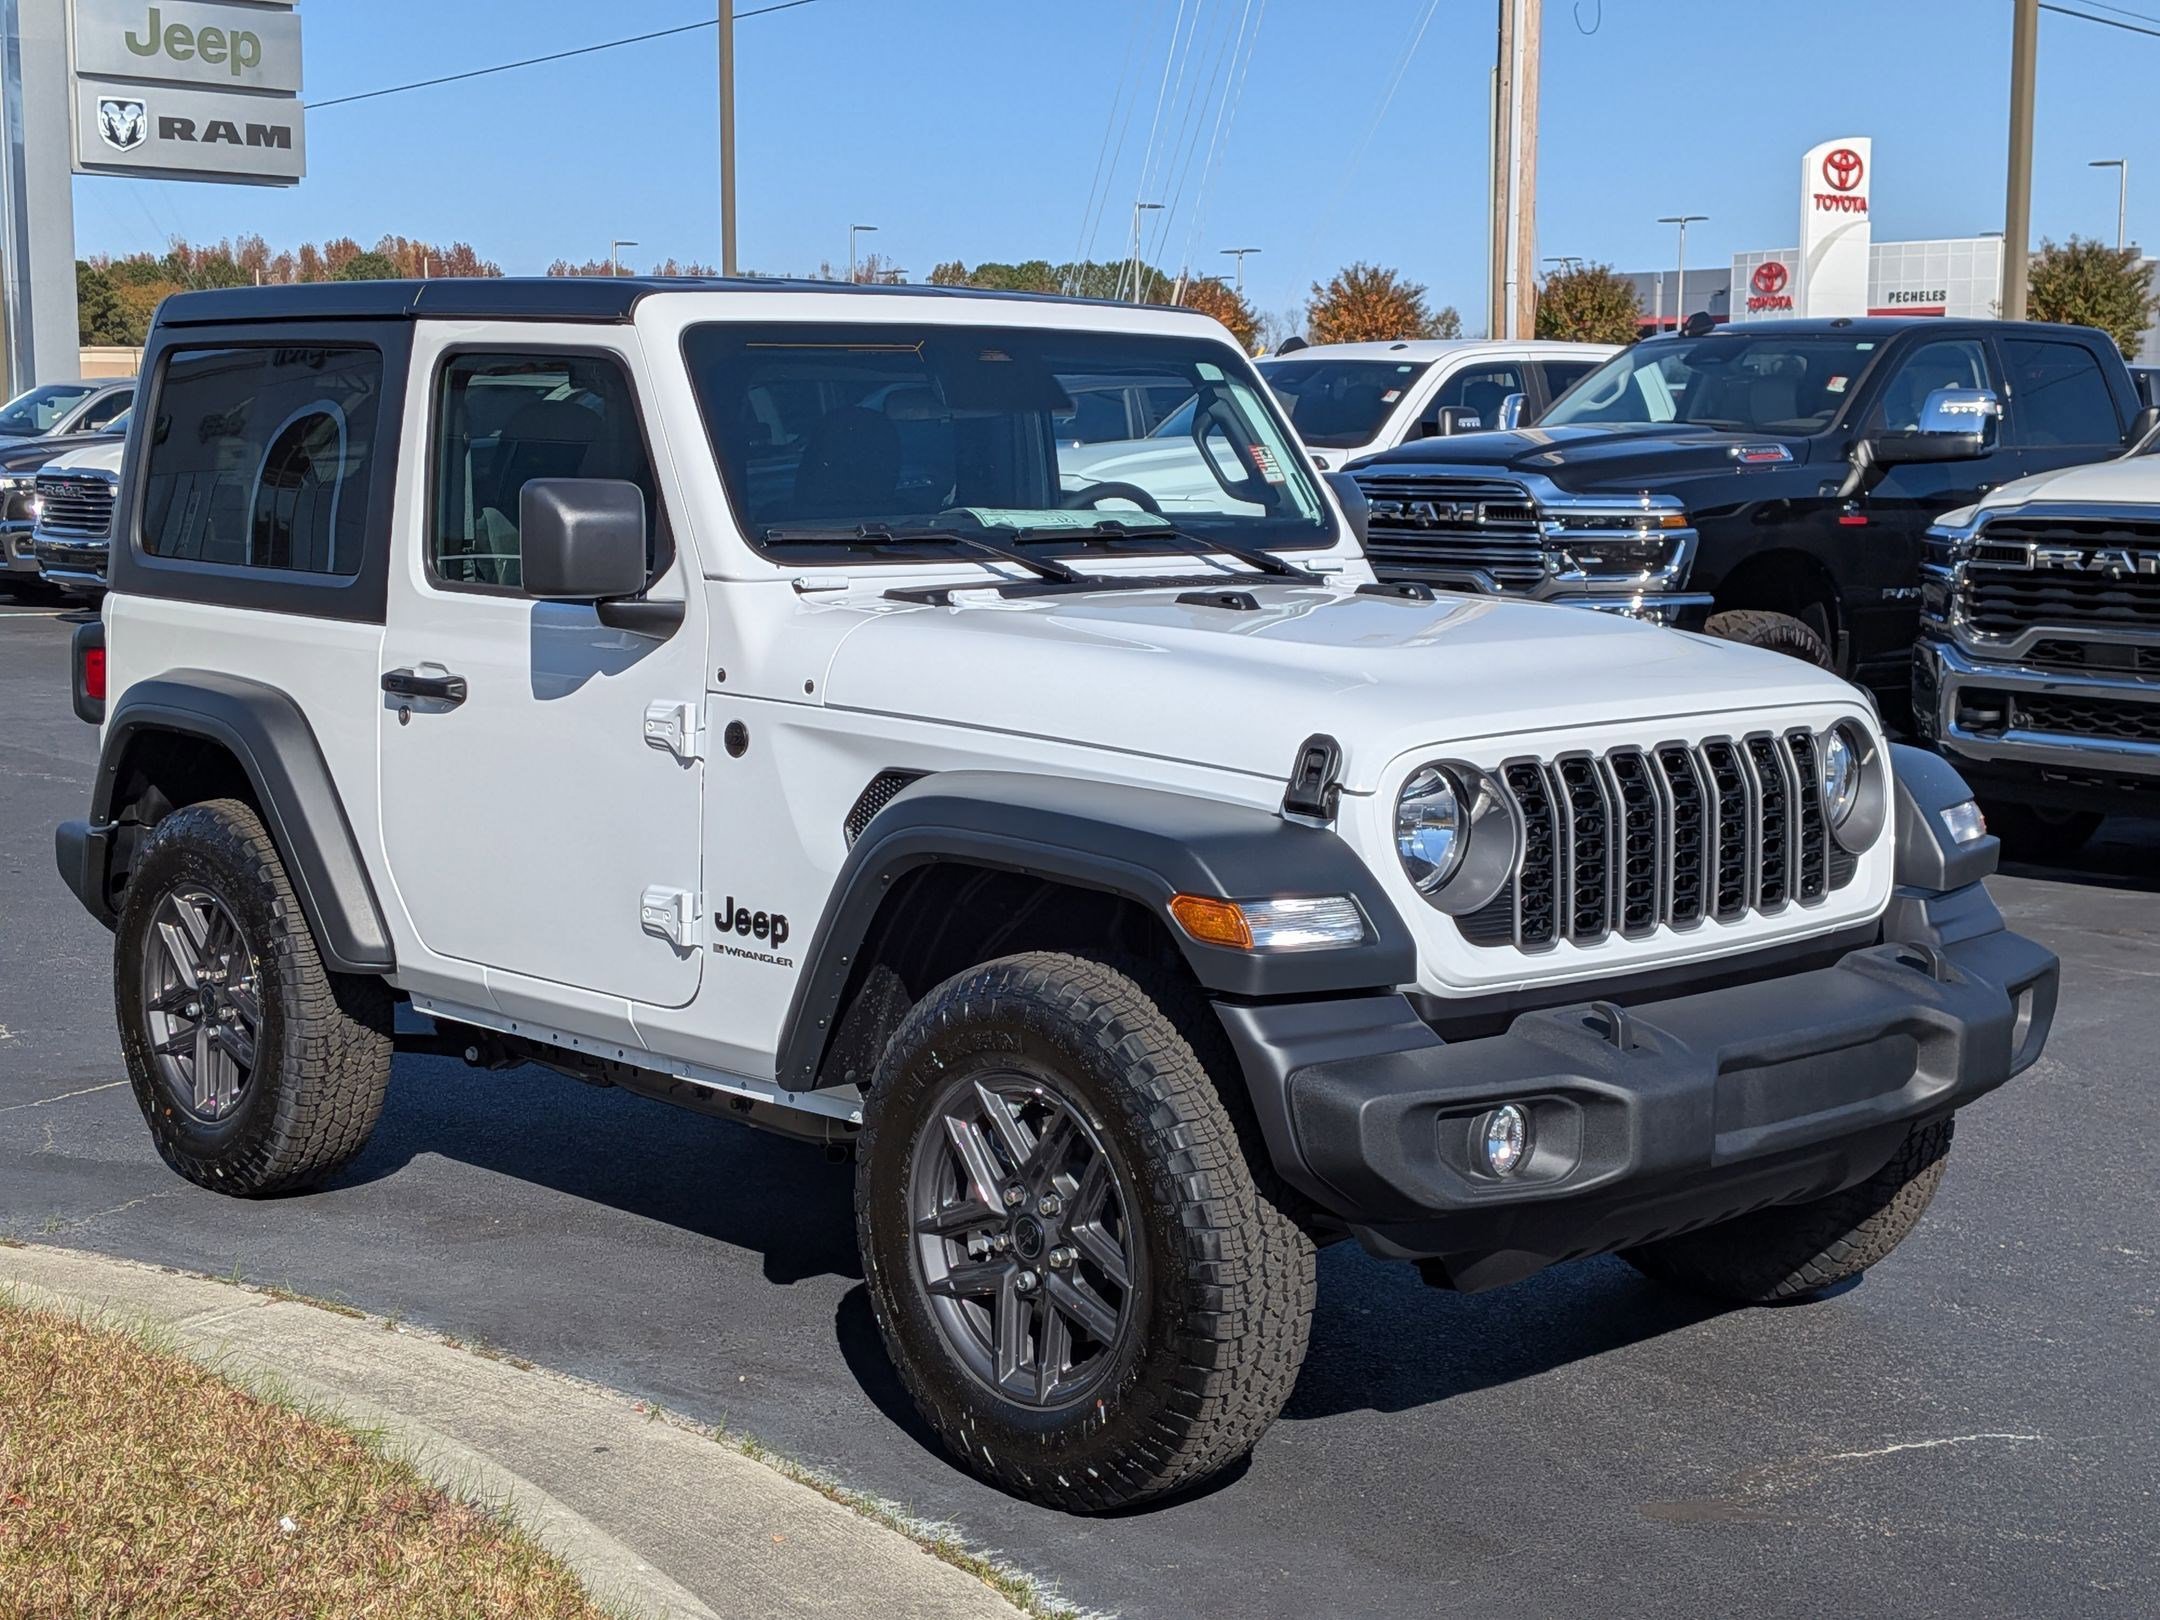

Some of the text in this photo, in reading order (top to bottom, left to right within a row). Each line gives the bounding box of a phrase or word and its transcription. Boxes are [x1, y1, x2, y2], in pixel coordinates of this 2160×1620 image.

[124, 7, 262, 76] Jeep
[158, 116, 292, 149] RAM
[1814, 193, 1868, 214] TOYOTA
[1747, 295, 1793, 313] TOYOTA
[1888, 290, 1947, 303] PECHELES
[714, 895, 789, 950] Jeep
[724, 945, 793, 968] WRANGLER
